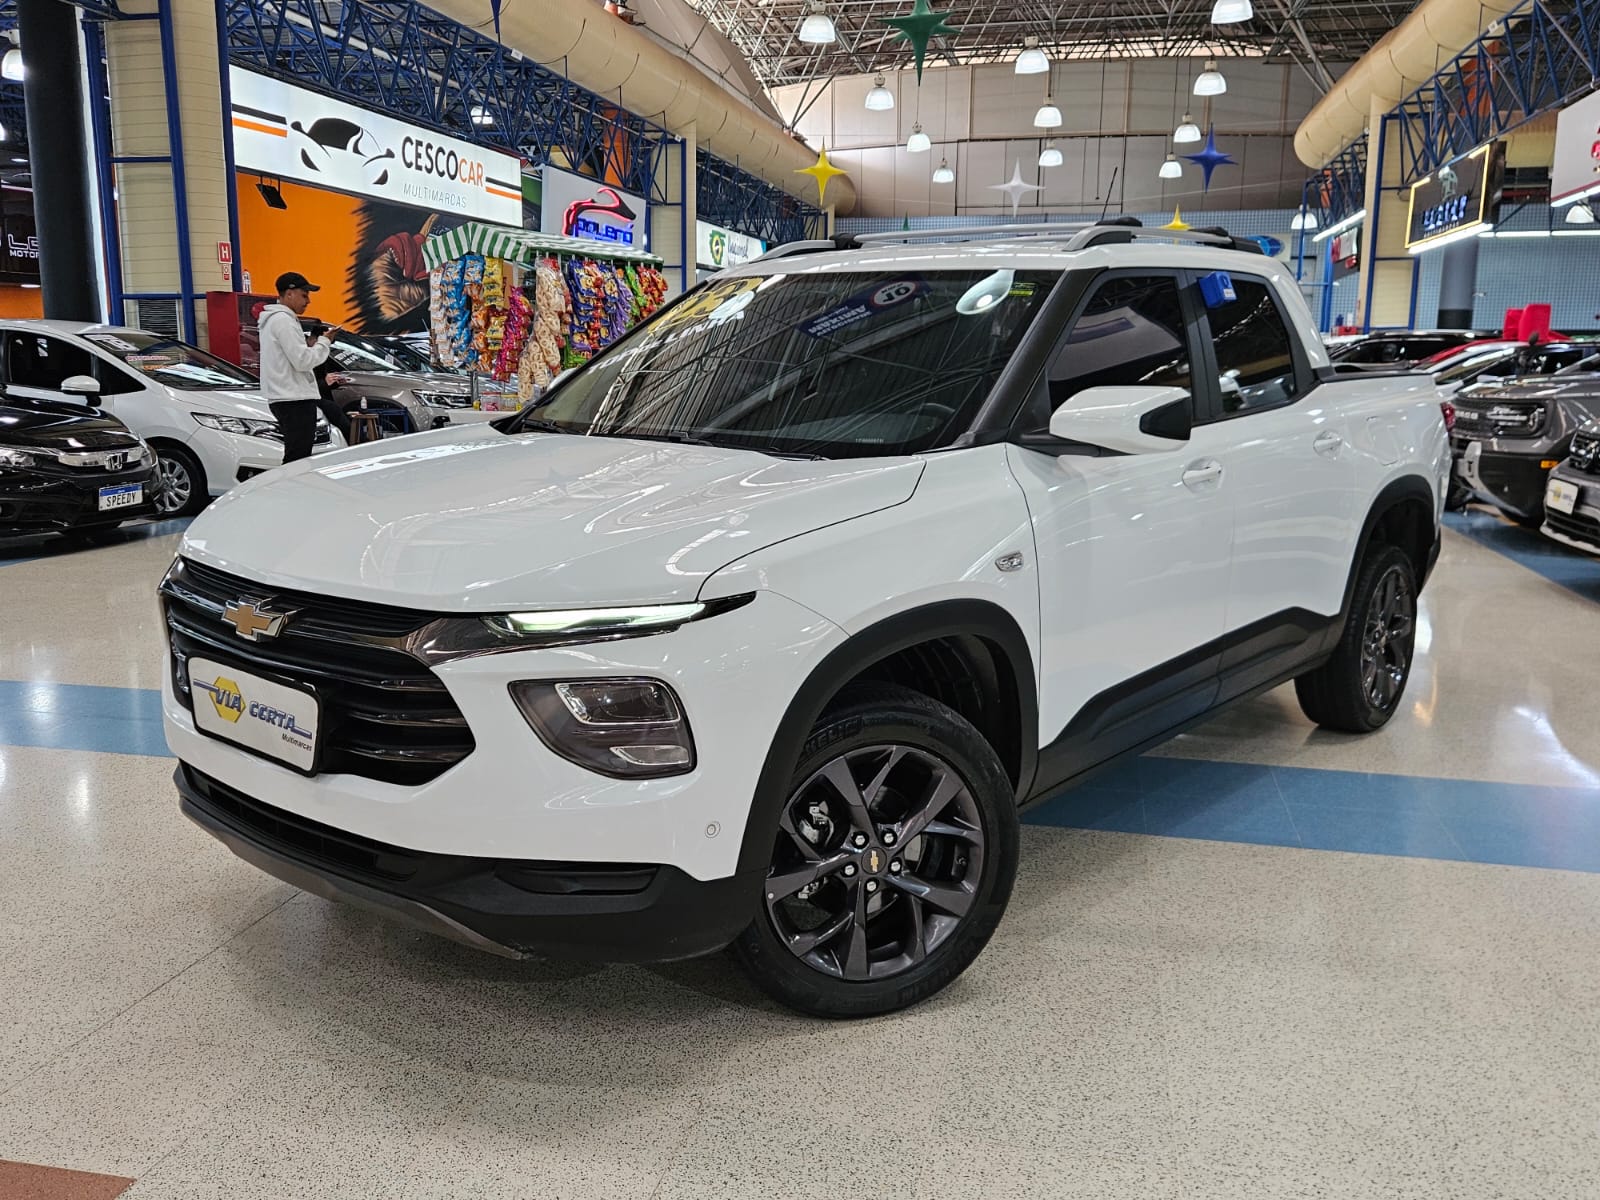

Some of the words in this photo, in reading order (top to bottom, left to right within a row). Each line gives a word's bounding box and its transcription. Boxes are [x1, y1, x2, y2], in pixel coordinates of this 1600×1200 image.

[401, 135, 485, 188] CESCOCAR
[403, 183, 468, 209] MULTIMARCAS
[106, 491, 136, 508] SPEEDY
[216, 688, 242, 712] VIA
[249, 700, 297, 731] CERTA
[281, 732, 313, 752] Multimarcas
